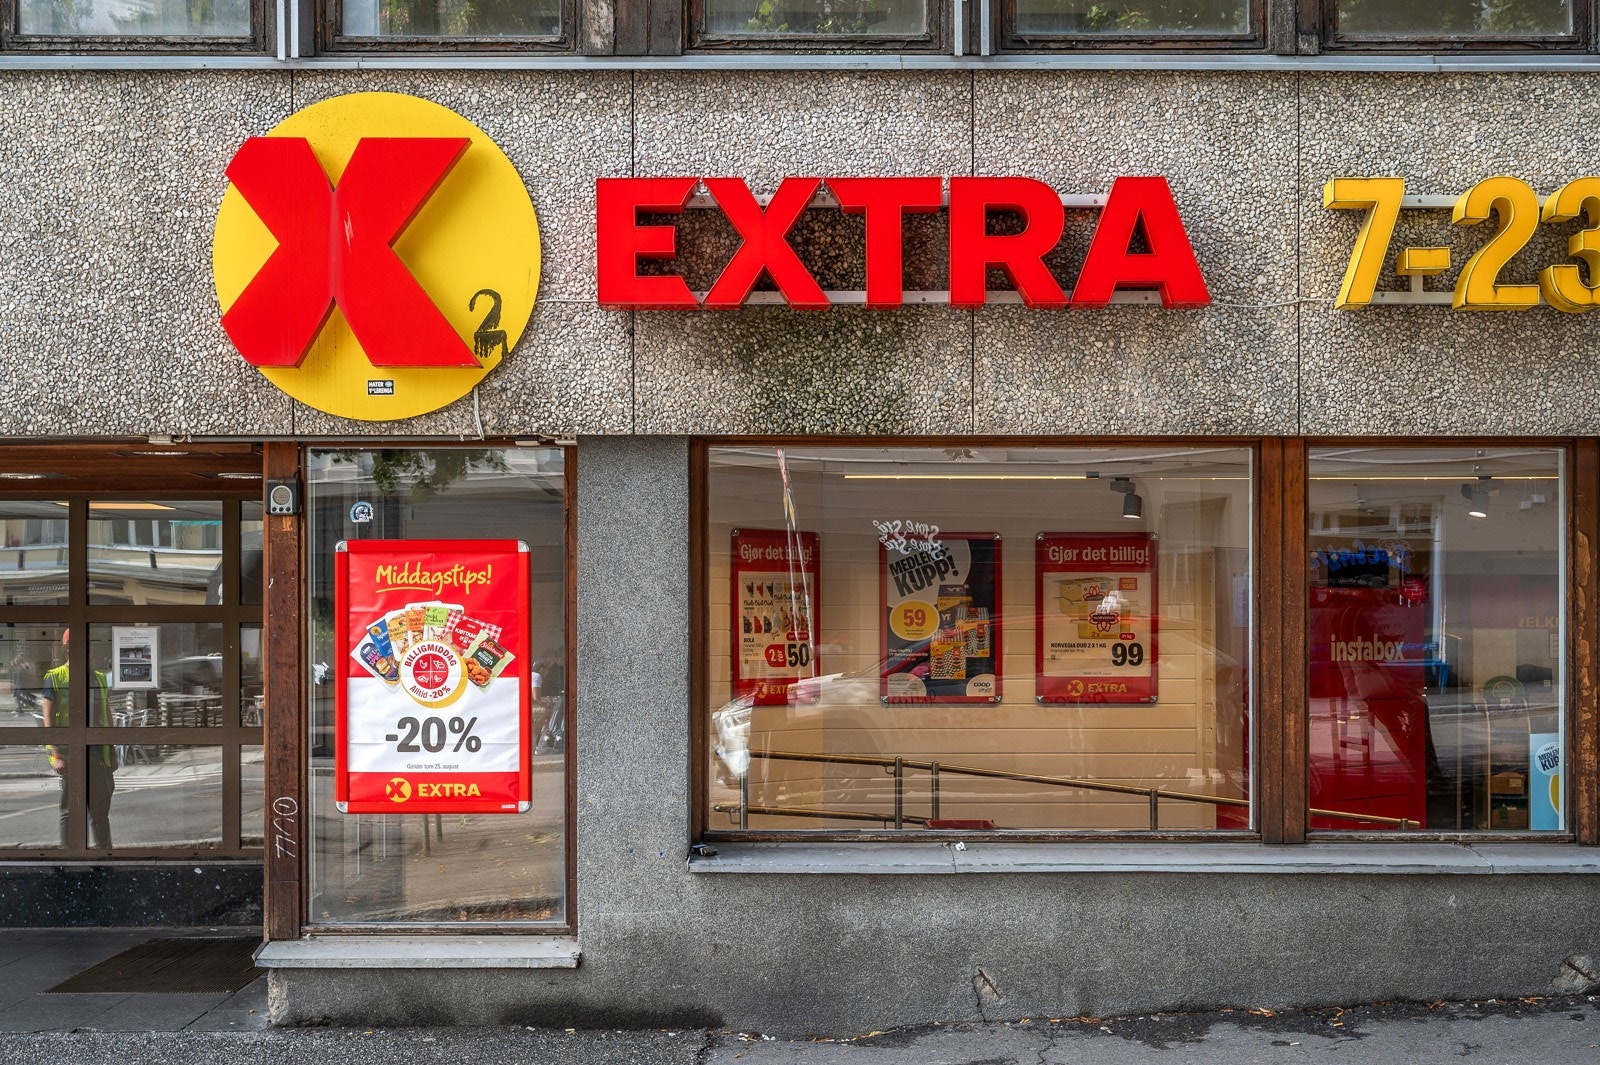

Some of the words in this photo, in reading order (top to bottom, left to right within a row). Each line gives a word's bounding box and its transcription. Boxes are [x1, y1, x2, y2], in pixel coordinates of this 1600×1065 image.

[595, 175, 1210, 308] EXTRA
[1322, 176, 1600, 313] 7-23
[740, 544, 763, 563] Gjør
[765, 545, 784, 560] det
[1048, 546, 1078, 564] Gjør
[1082, 546, 1106, 561] det
[1110, 546, 1150, 564] billig!
[375, 561, 493, 595] Middagstips!
[894, 555, 959, 598] KUPP!
[903, 609, 926, 627] 59
[404, 644, 458, 668] BILLIGMIDDAG
[768, 648, 776, 662] 2
[788, 644, 810, 668] 50
[1111, 642, 1144, 667] 99
[1330, 633, 1406, 662] instabox
[410, 685, 428, 698] Alltid
[429, 685, 452, 699] -20%
[770, 685, 797, 694] EXT
[1088, 684, 1127, 692] EXTRA
[386, 716, 482, 753] -20%
[418, 782, 482, 798] EXTRA
